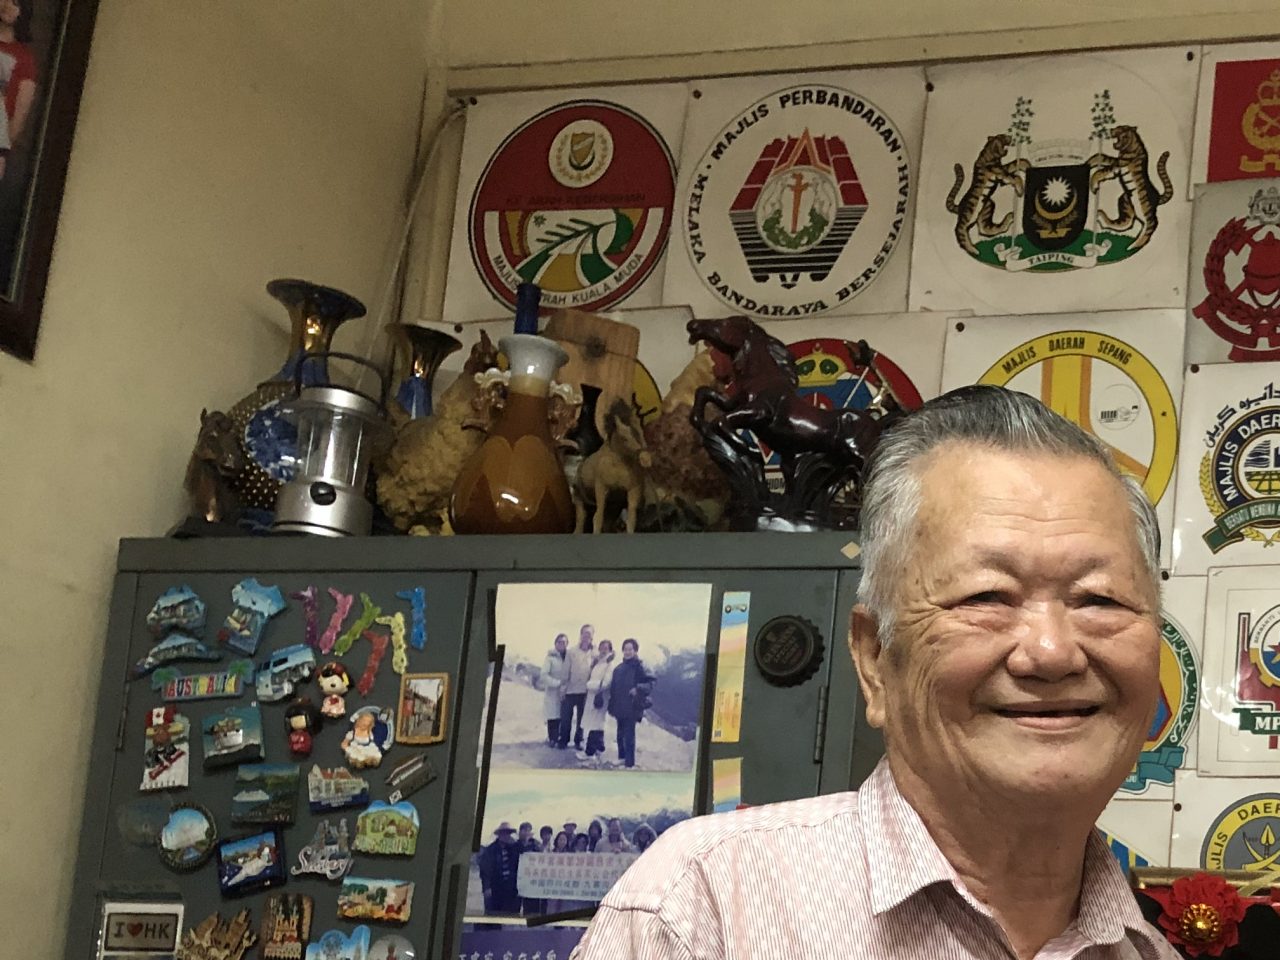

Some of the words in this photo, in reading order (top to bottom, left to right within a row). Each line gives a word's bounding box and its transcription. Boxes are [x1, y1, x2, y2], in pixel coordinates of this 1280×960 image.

[711, 103, 769, 160] MAJLIS
[779, 89, 902, 154] PERBANDARAN
[687, 173, 709, 265] MELAKA
[707, 271, 829, 316] BANDARAYA
[835, 163, 910, 302] BERSEJARAH
[1029, 253, 1074, 266] TAIPING
[493, 255, 519, 291] MAJLIS
[572, 285, 611, 303] KUALA
[613, 253, 644, 284] MUDA
[1002, 346, 1037, 374] MAJLIS
[1048, 337, 1085, 352] DAERAH
[1097, 340, 1133, 365] SEPANG
[1218, 441, 1238, 501] MAJLIS
[167, 674, 236, 697] AUSTRALIA
[114, 922, 125, 938] I
[144, 922, 170, 939] HK
